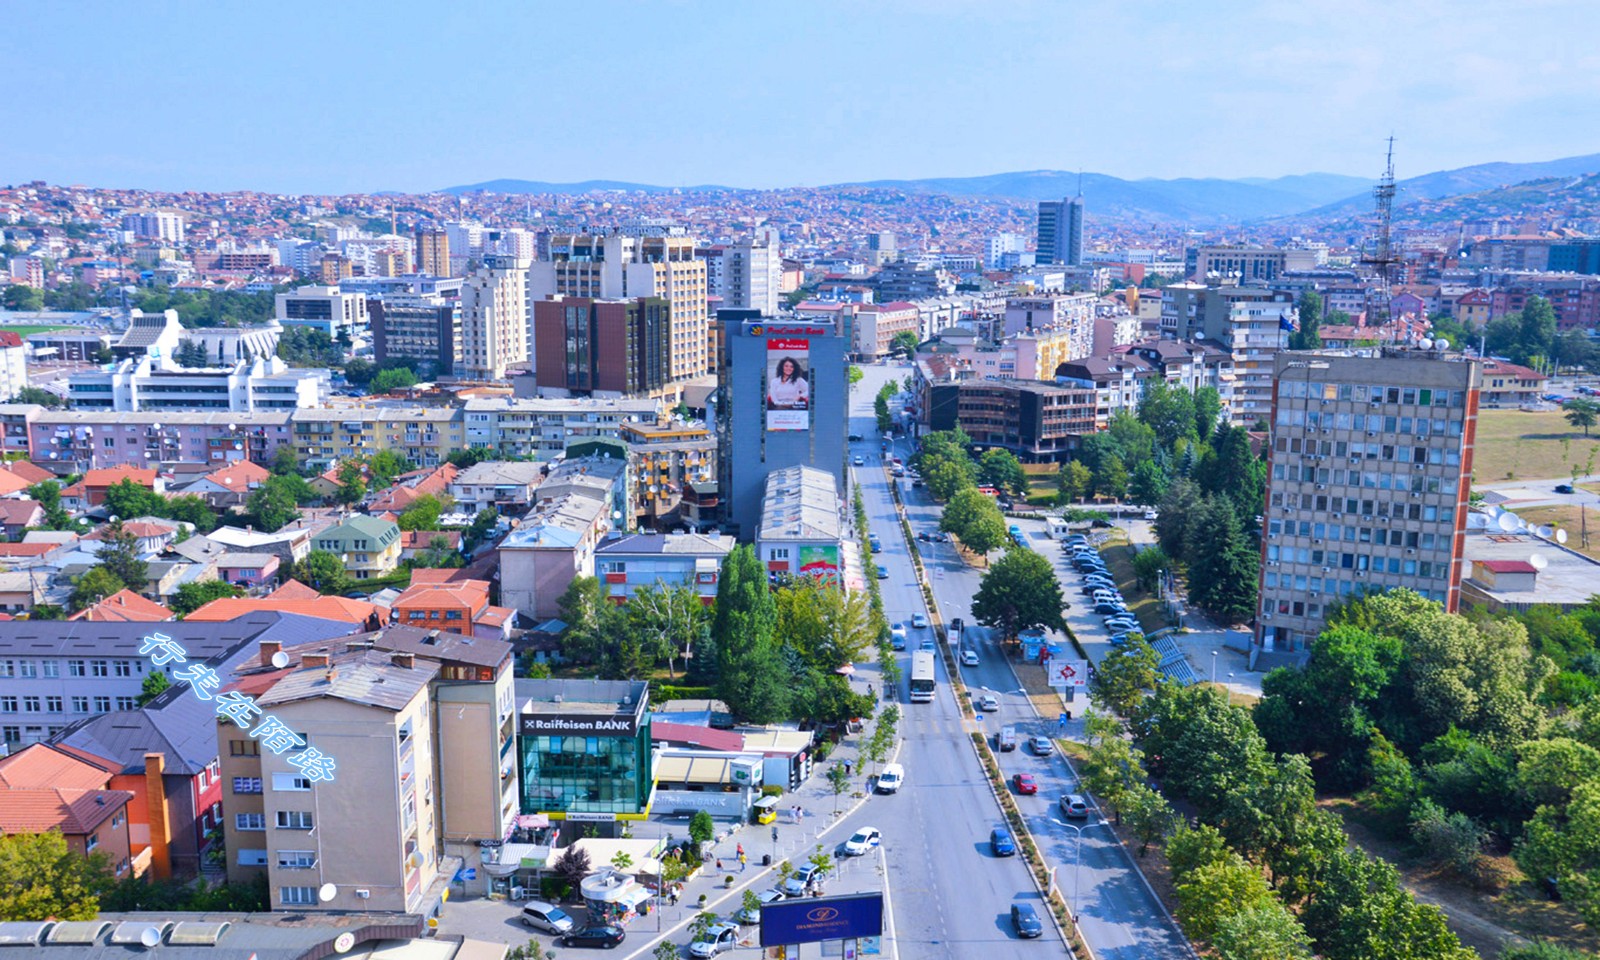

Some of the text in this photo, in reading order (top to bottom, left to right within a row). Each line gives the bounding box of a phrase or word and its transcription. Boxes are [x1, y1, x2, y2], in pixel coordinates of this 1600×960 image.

[767, 326, 825, 335] ProCredit Bank
[536, 719, 631, 730] Raiffeisen BANK
